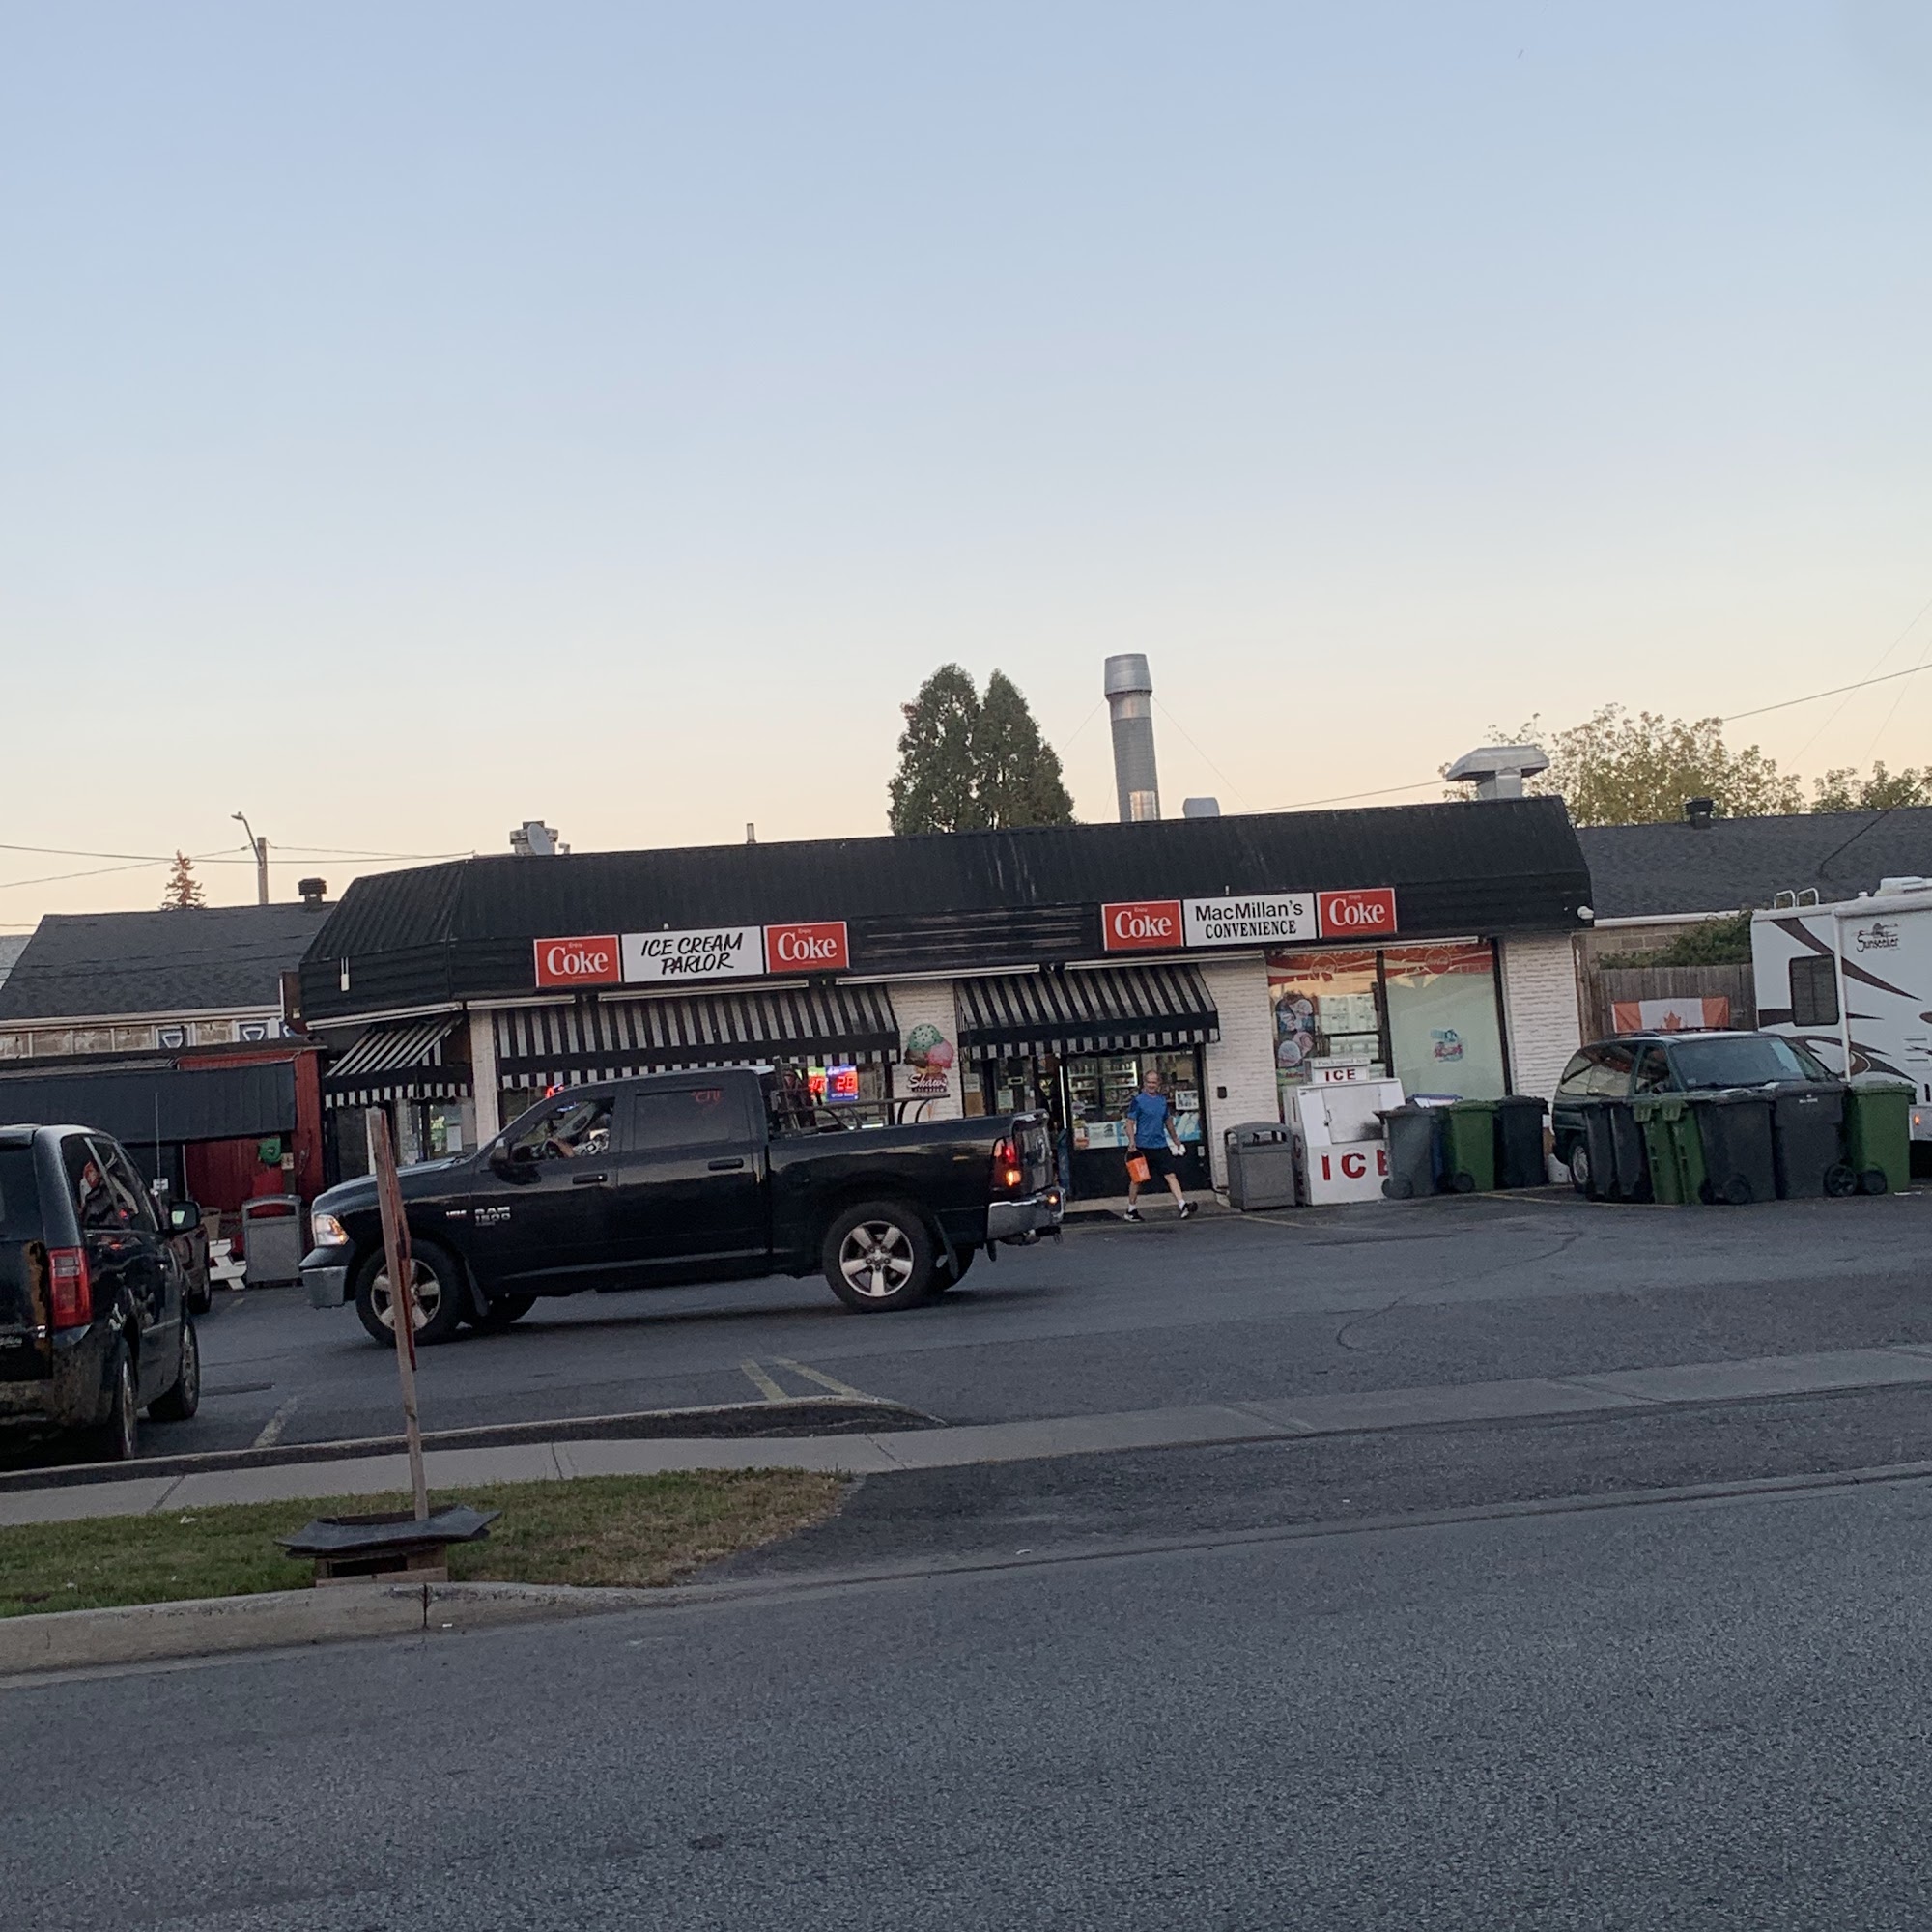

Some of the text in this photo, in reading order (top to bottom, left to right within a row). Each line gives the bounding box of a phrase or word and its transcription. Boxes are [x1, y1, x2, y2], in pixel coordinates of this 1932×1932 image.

[1195, 900, 1304, 922] MacMillan's
[1329, 898, 1386, 926] Coke
[1114, 911, 1172, 939] Coke
[1205, 920, 1297, 940] CONVENIENCE
[640, 932, 744, 957] ICE CREAM
[776, 932, 838, 961] Coke
[546, 946, 609, 976] Coke
[661, 952, 735, 975] PARLOR
[1324, 1068, 1357, 1082] ICE
[474, 1206, 511, 1215] RAM
